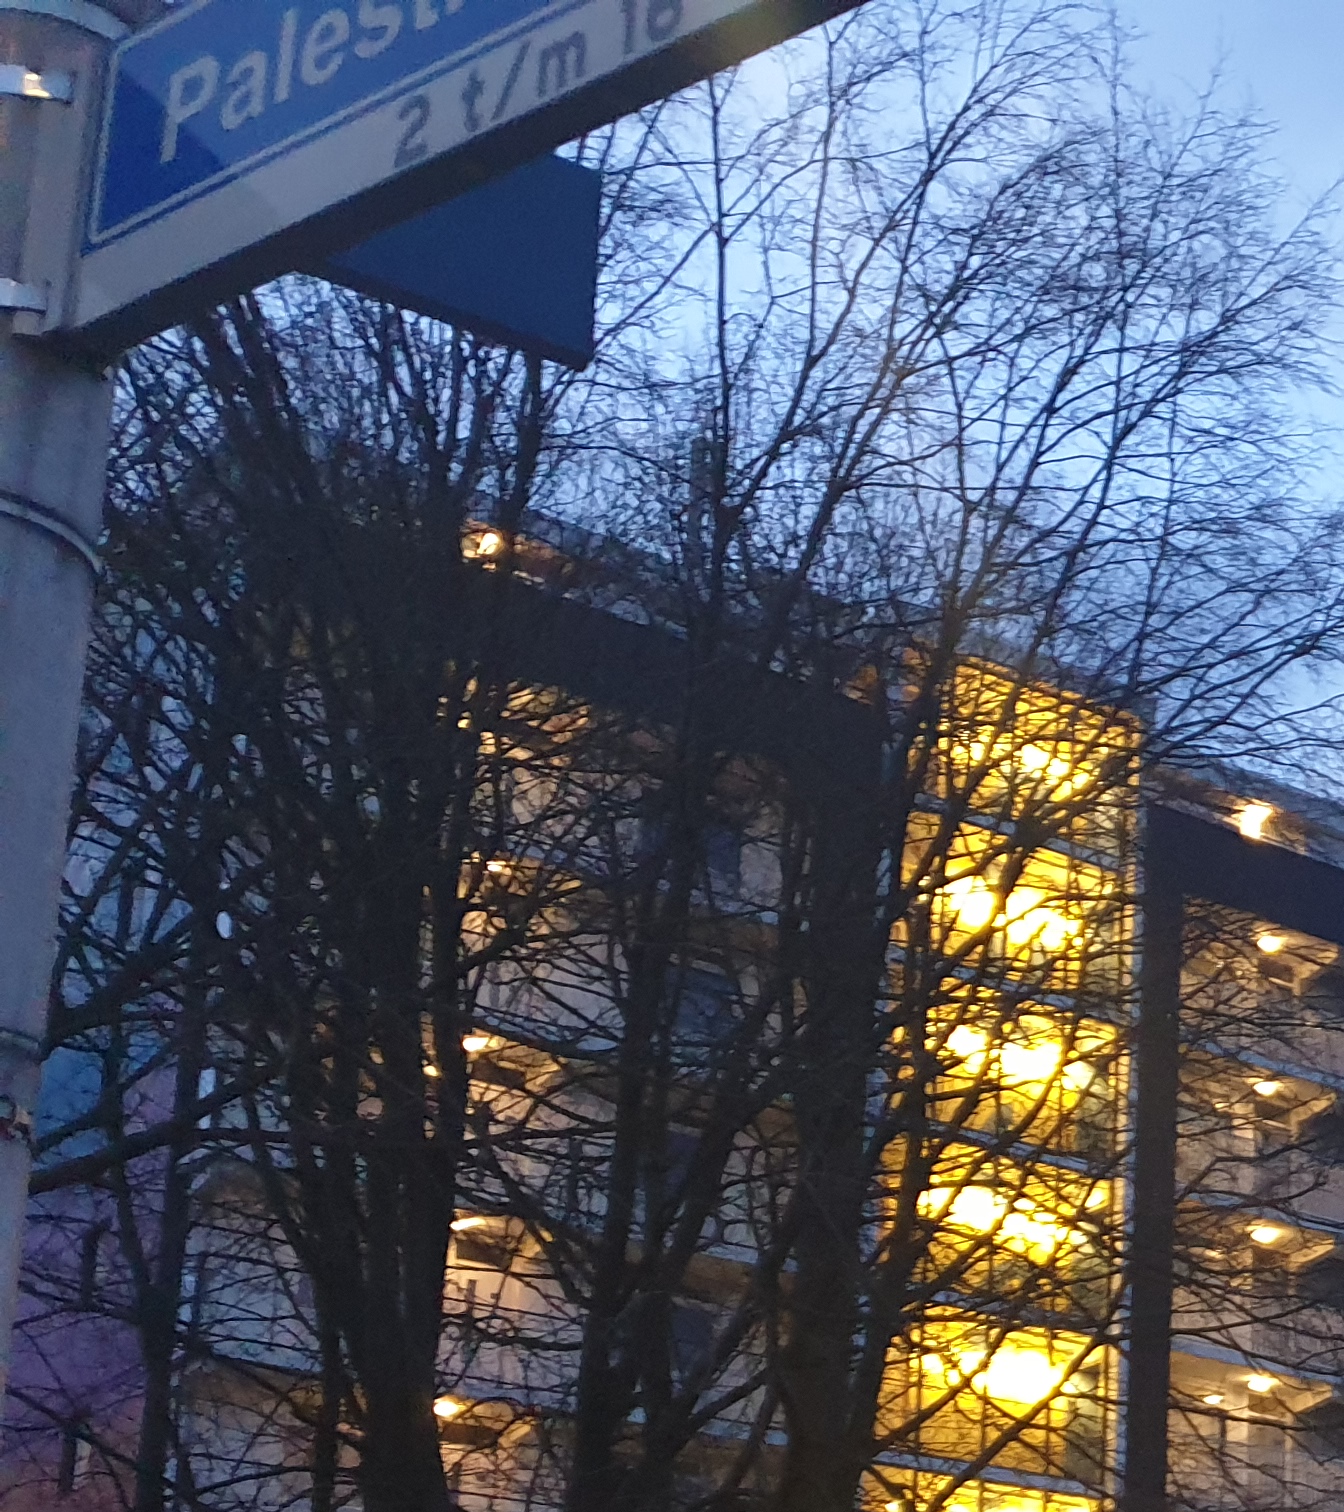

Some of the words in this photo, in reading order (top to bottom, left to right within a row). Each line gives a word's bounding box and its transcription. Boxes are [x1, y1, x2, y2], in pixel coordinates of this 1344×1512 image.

[160, 0, 464, 164] Pales
[394, 94, 430, 169] 2
[461, 30, 587, 133] t/m
